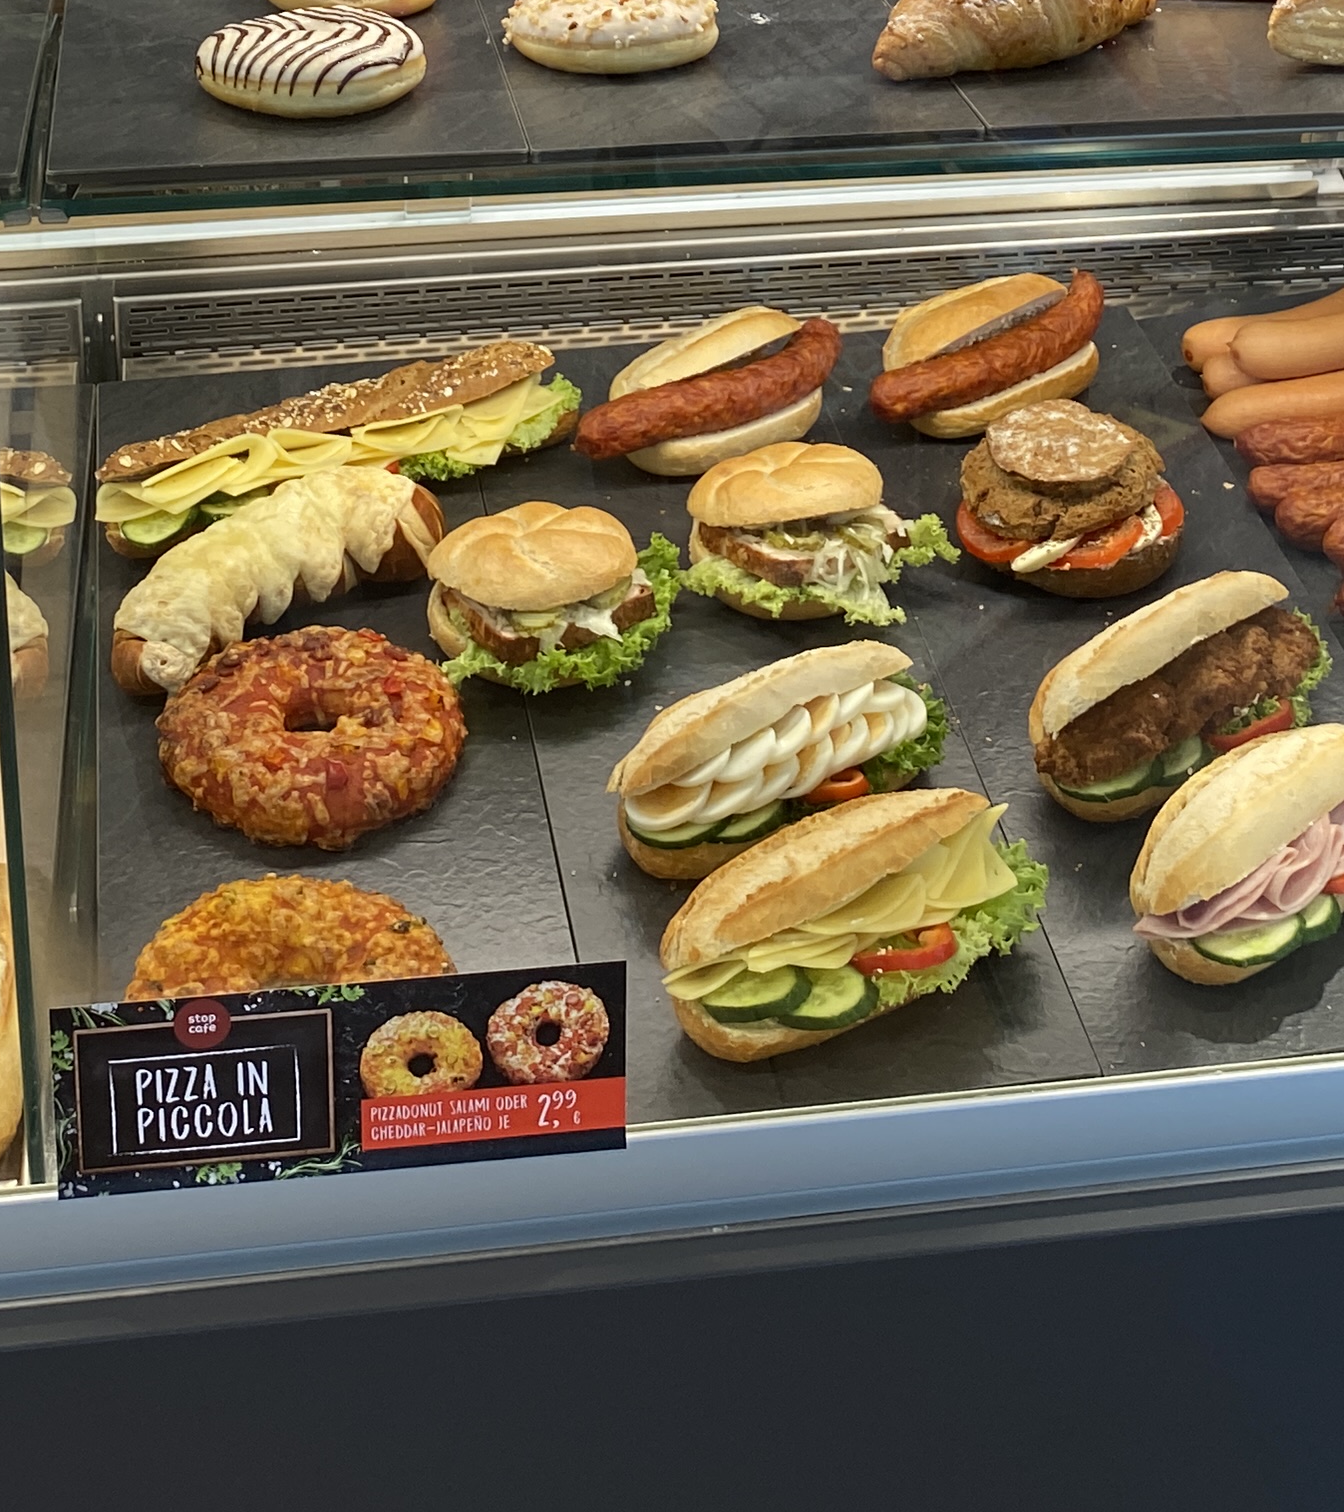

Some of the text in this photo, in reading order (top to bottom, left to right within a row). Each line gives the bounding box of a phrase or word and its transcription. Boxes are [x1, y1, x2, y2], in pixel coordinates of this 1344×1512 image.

[188, 1012, 216, 1027] stop
[189, 1021, 217, 1035] cafe
[135, 1060, 268, 1105] PIZZA IN
[369, 1095, 528, 1121] PIZZADONUT SALAMI ODER
[138, 1100, 272, 1144] PICCOLA
[370, 1114, 511, 1142] CHEDDAR-JALAPEÑO JE
